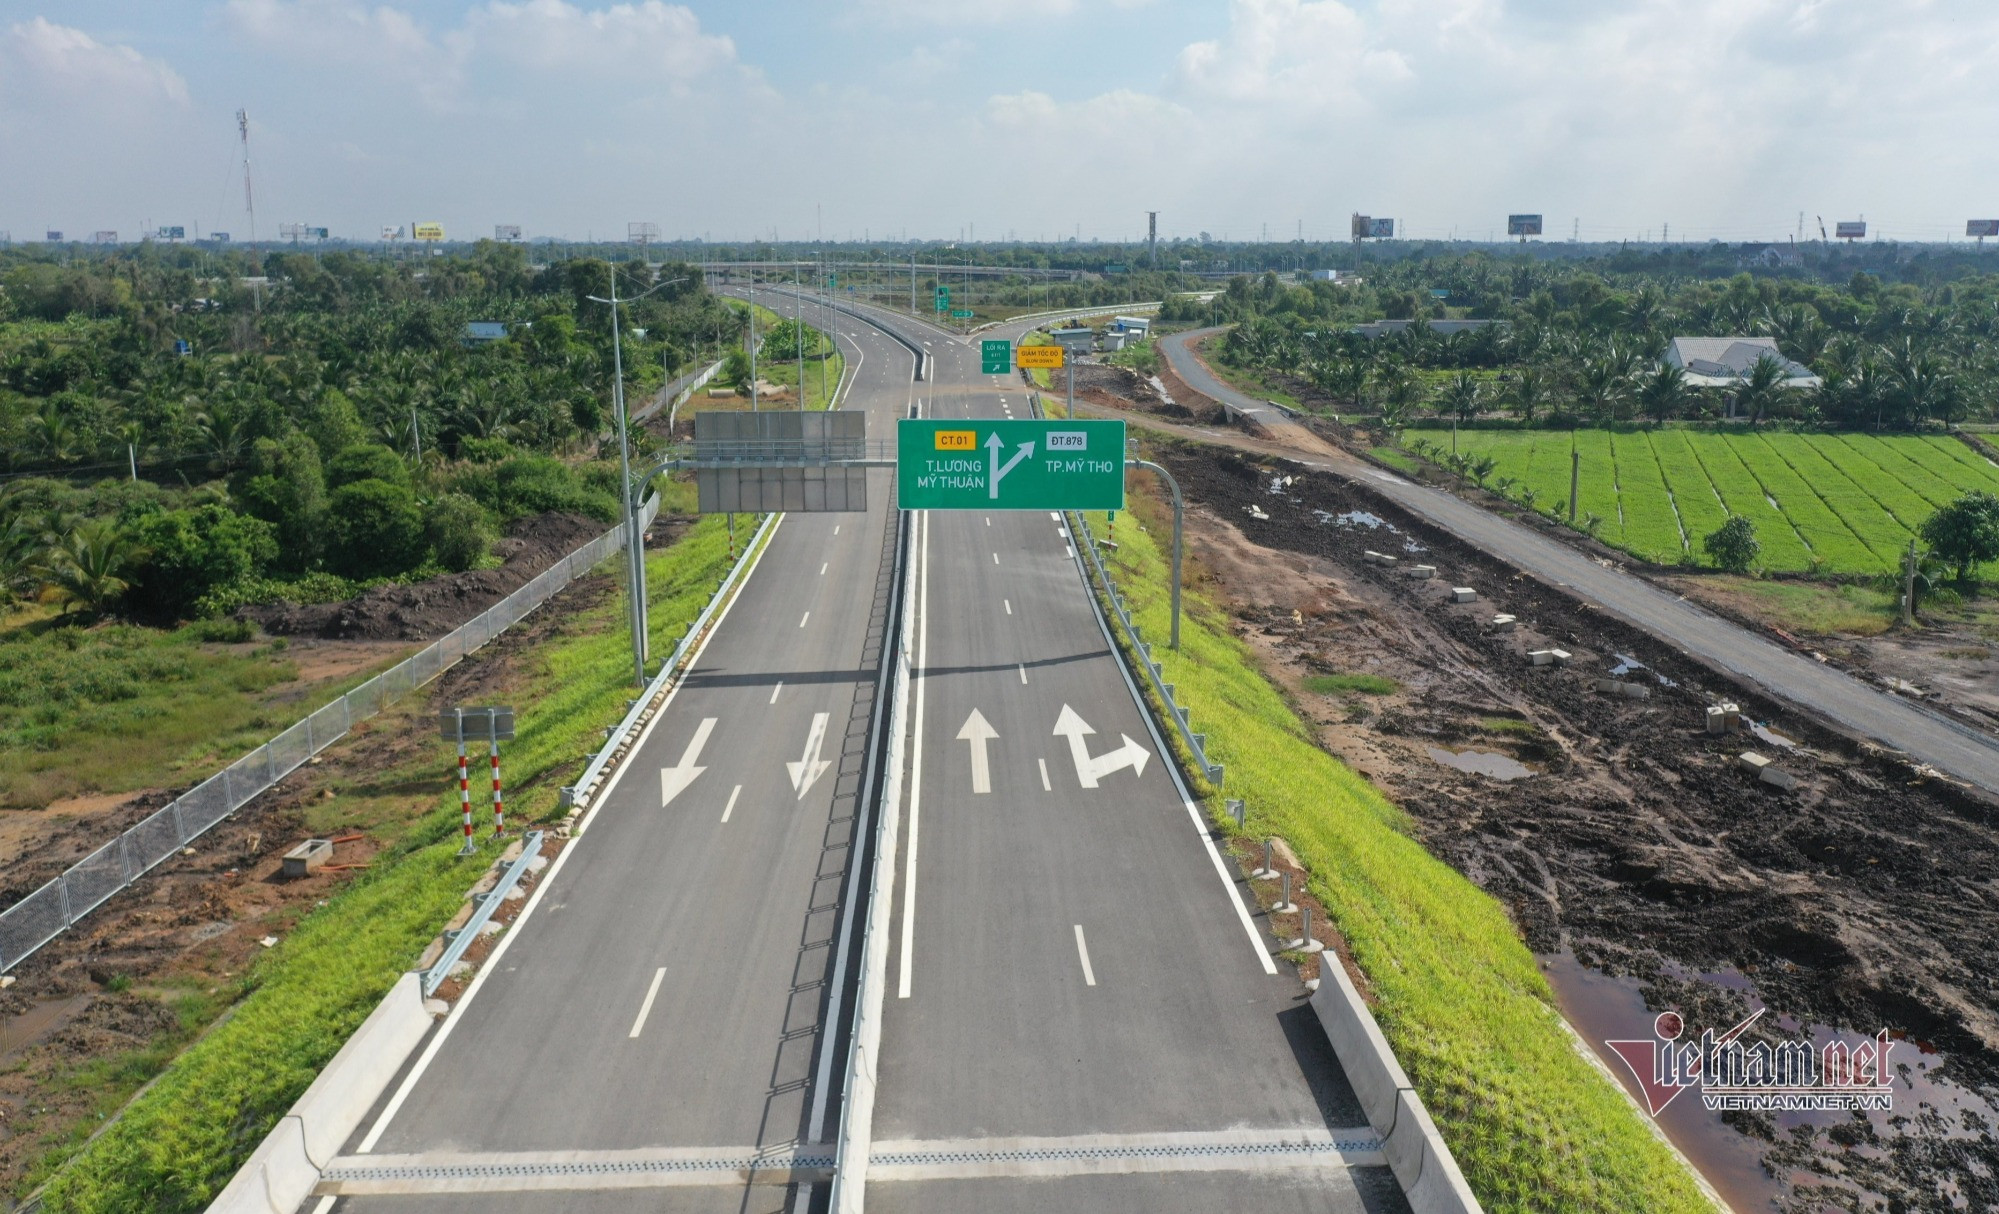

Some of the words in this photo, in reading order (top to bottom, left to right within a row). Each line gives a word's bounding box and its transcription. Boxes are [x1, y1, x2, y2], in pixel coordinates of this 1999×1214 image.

[941, 434, 968, 445] CT.01
[1051, 436, 1082, 446] ĐT.878
[927, 459, 982, 473] T.LƯƠNG
[1089, 460, 1113, 473] THO
[918, 473, 936, 488] MỸ
[940, 473, 984, 491] THUẬN
